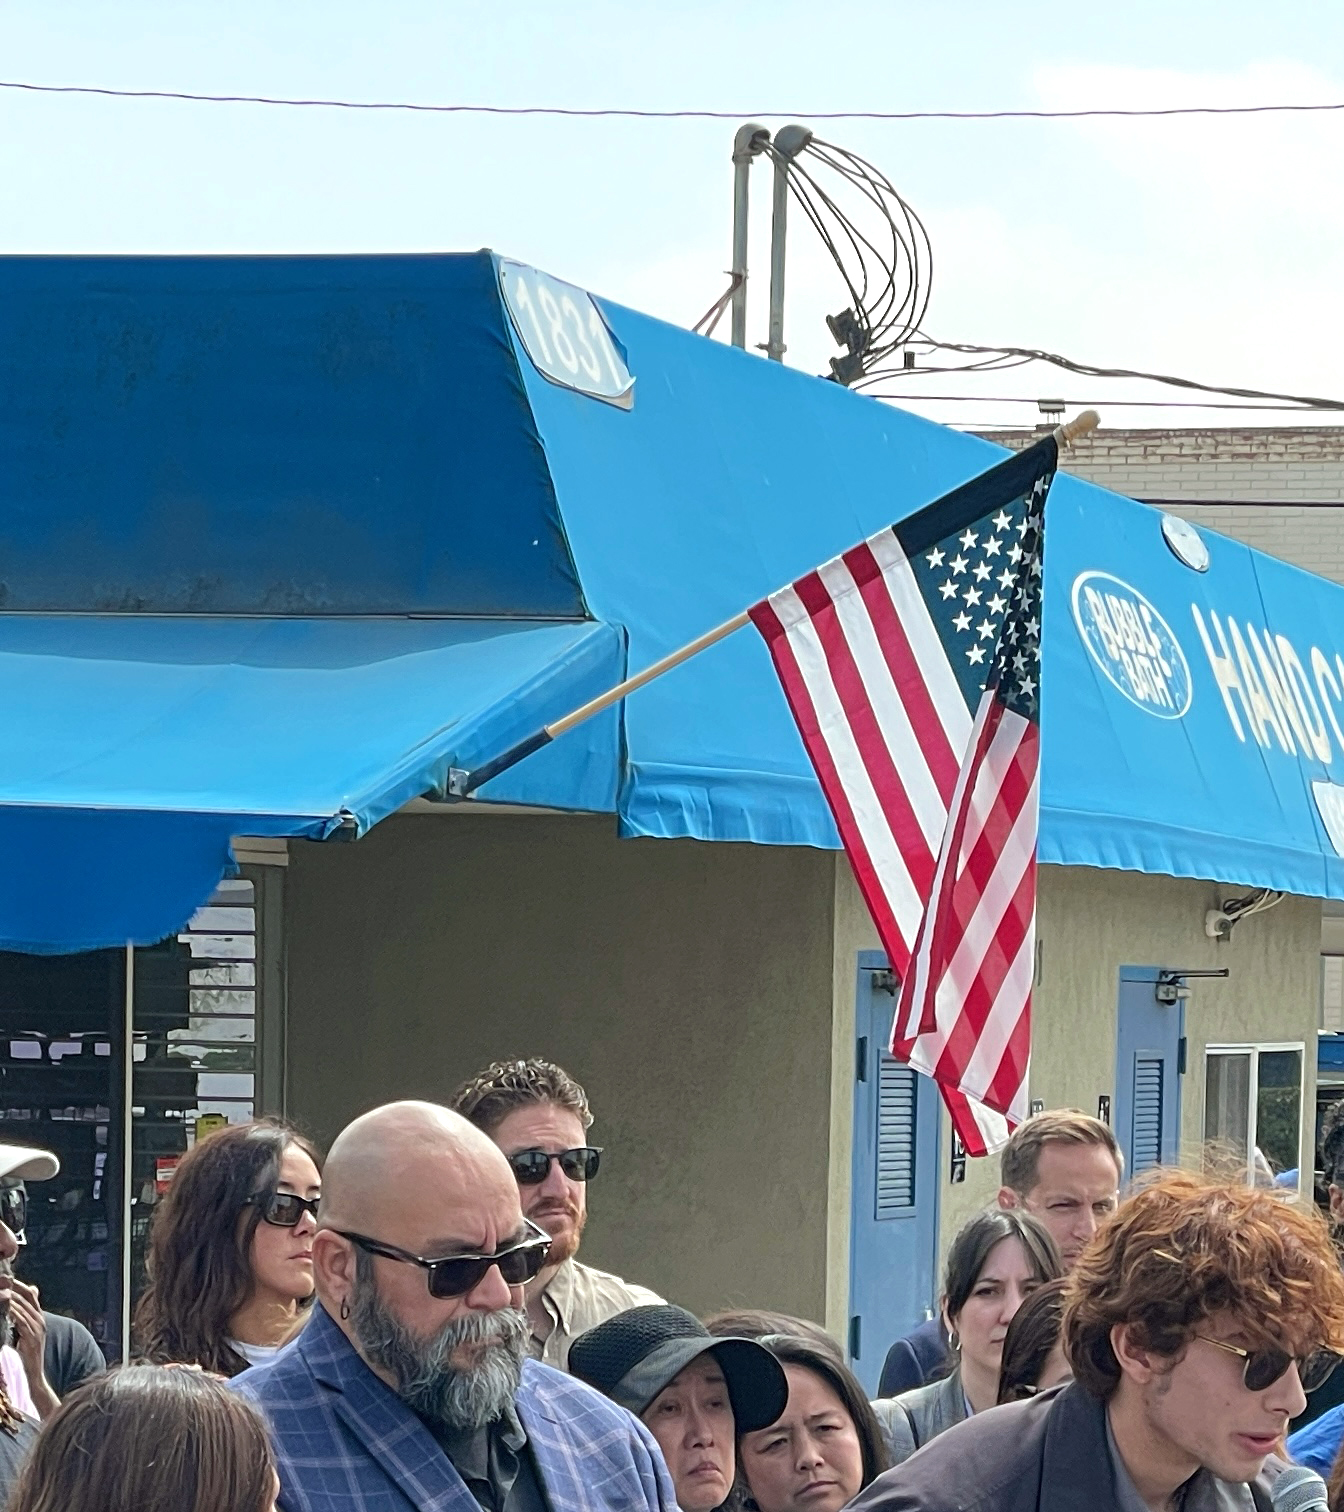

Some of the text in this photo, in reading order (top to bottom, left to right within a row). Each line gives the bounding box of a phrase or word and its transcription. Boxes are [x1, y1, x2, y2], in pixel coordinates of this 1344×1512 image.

[1084, 586, 1172, 677] BUBBLE
[1120, 650, 1174, 709] BATH
[1191, 602, 1332, 764] HAND
